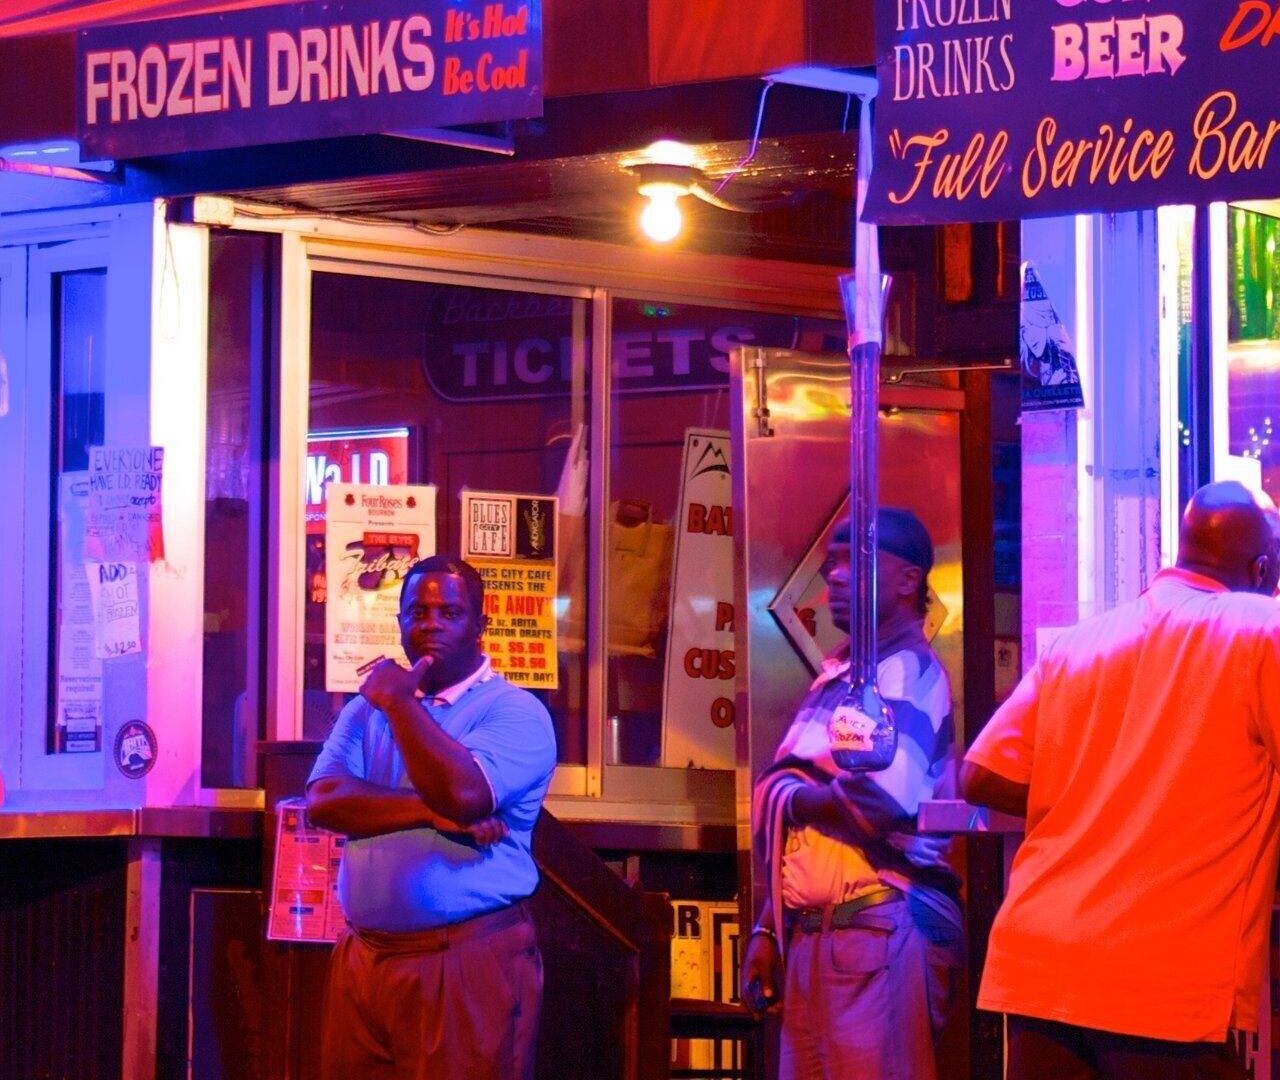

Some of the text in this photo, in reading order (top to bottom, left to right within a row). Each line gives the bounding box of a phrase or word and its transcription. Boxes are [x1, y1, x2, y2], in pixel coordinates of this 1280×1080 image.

[482, 3, 528, 39] Hot
[1050, 13, 1187, 82] BEER
[86, 15, 434, 125] FROZEN DRINKS
[443, 49, 526, 96] Be Cool
[893, 34, 1015, 102] DRINKS
[1022, 117, 1175, 199] Service
[94, 447, 163, 472] EVERYONE
[90, 473, 115, 492] HAVE
[472, 503, 507, 523] BLUES
[99, 563, 127, 584] ADD
[501, 568, 523, 578] CITY
[528, 570, 551, 580] CAFE
[528, 582, 545, 591] THE
[520, 628, 552, 639] DRAFTS
[504, 671, 530, 681] EVERY
